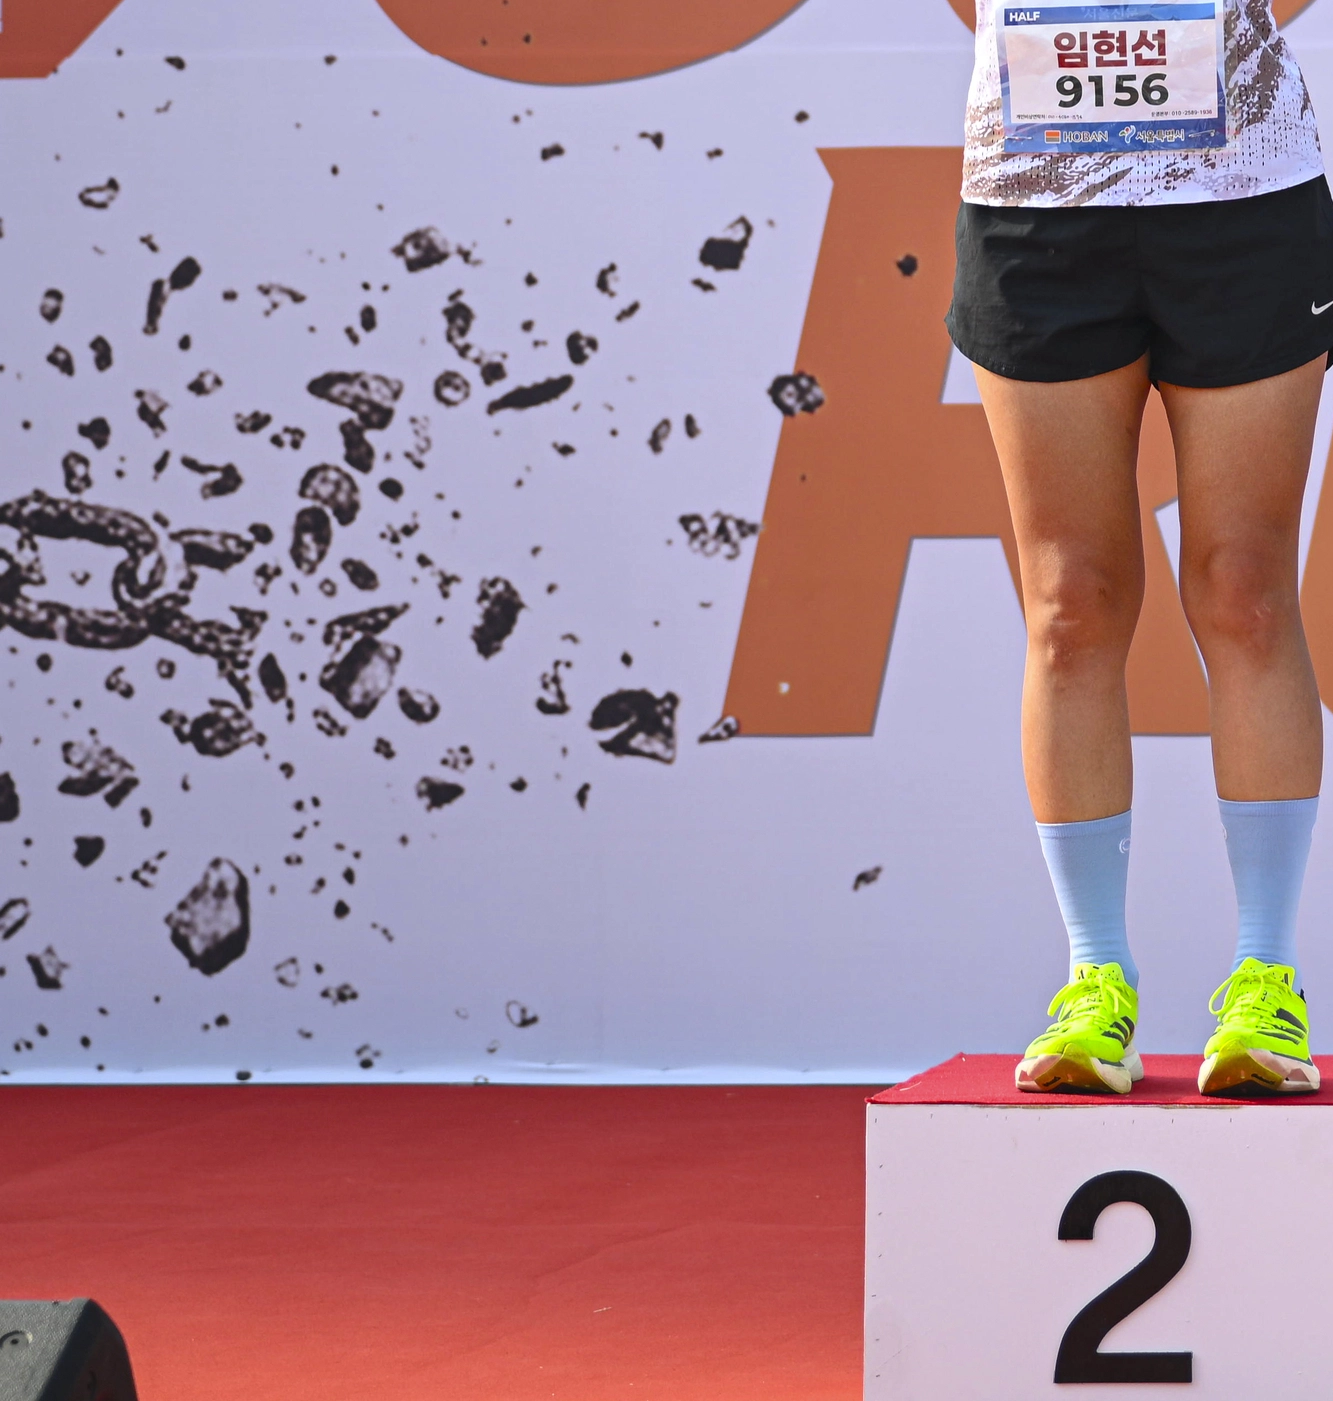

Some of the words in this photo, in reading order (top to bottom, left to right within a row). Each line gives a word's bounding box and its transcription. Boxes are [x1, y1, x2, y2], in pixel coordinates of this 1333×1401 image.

[1009, 11, 1040, 22] HALF
[1054, 29, 1167, 68] 임현선
[1056, 74, 1168, 108] 9156
[1063, 130, 1108, 143] HOBAN
[1136, 128, 1185, 143] 서울특별시
[1054, 1171, 1193, 1385] 2
